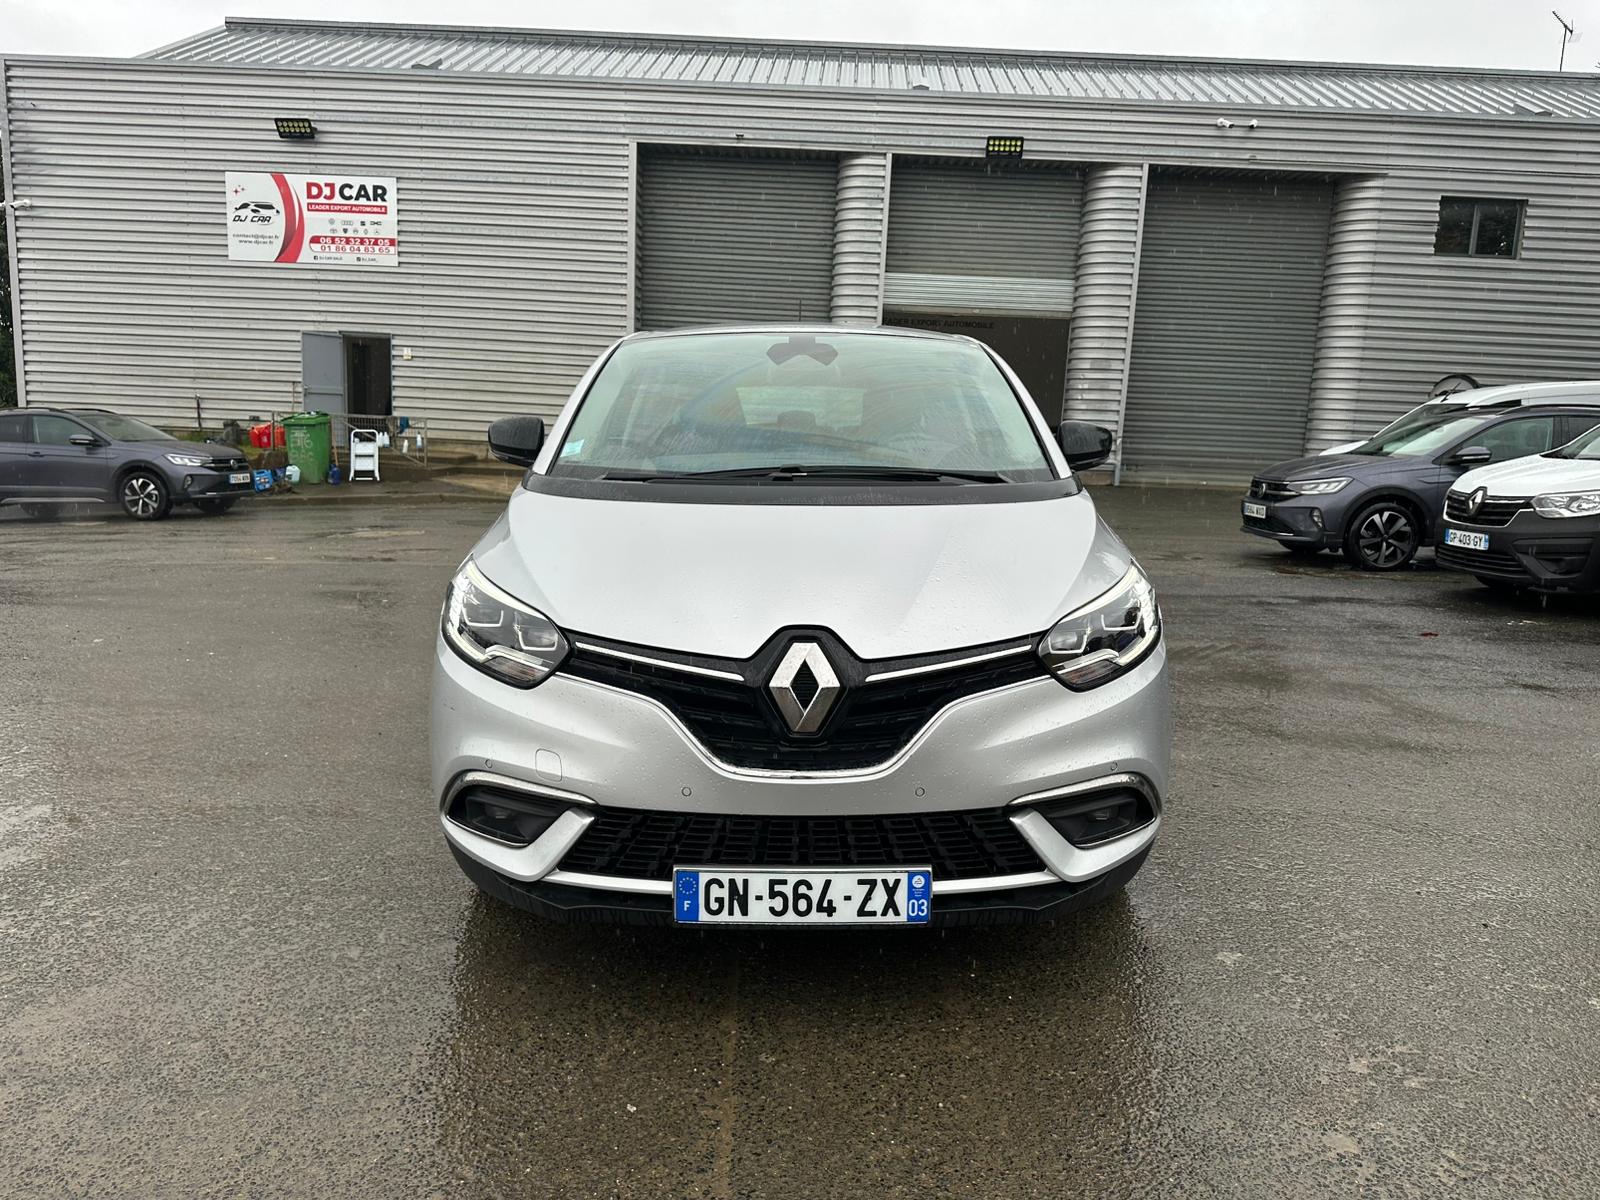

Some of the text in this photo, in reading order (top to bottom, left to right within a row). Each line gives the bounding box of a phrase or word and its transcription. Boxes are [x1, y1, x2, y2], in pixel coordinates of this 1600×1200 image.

[306, 181, 388, 202] DJ CAR
[351, 205, 386, 213] AUTOMOBILE
[232, 214, 272, 223] DJ CAR
[319, 236, 332, 244] 06
[883, 317, 909, 325] EADER
[944, 319, 995, 329] AUTOMOBILE
[683, 900, 691, 912] F
[703, 878, 902, 917] GN-564-ZX
[908, 899, 928, 917] 03
